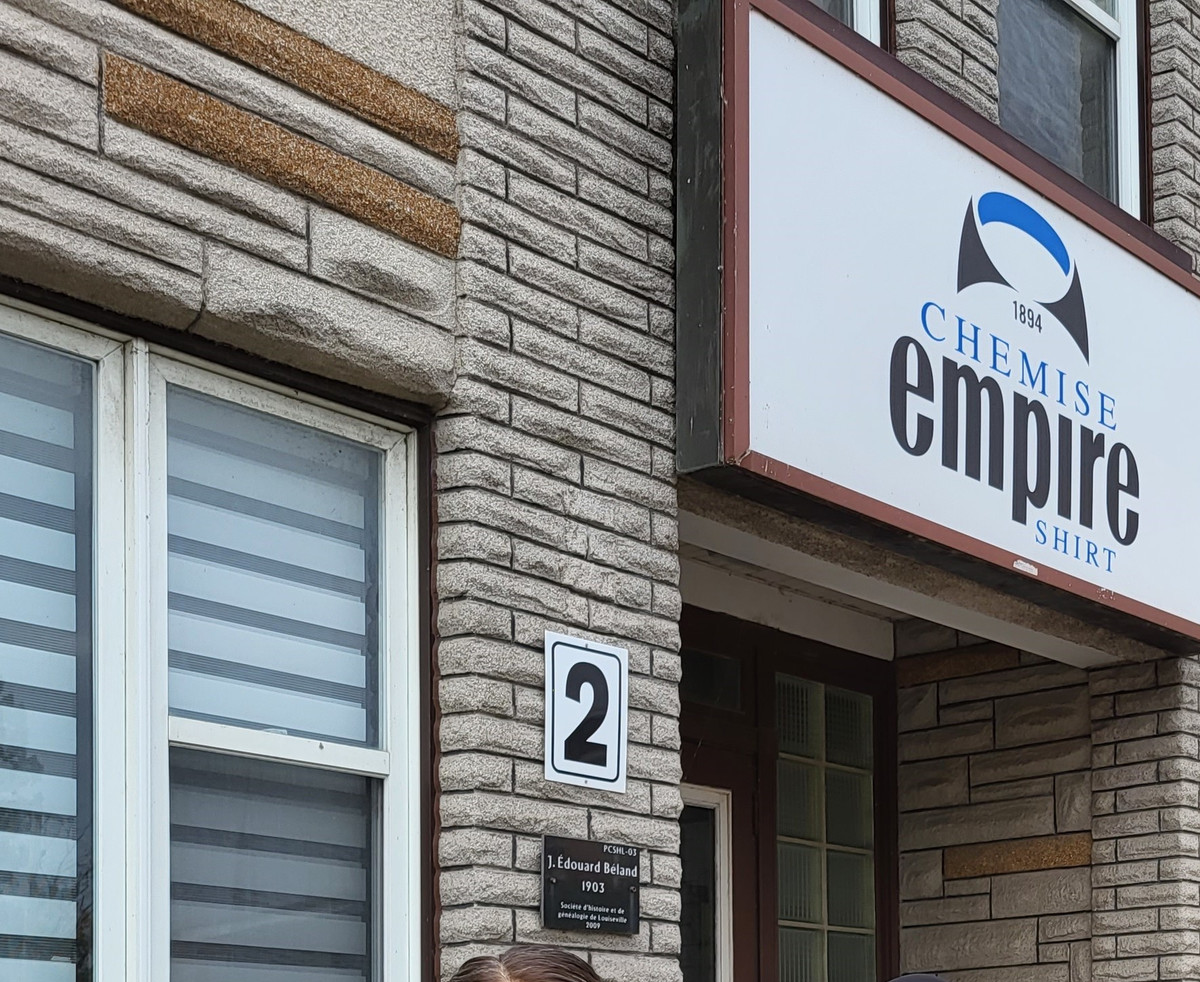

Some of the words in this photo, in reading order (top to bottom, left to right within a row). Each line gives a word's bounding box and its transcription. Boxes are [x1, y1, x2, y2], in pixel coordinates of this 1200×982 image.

[1012, 299, 1043, 333] 1894
[920, 301, 1118, 431] CHEMISE
[889, 335, 1140, 546] empire
[1035, 520, 1117, 573] SHIRT
[564, 661, 609, 767] 2
[603, 844, 637, 857] PCSHL-03
[547, 855, 556, 869] J.
[557, 854, 601, 873] Édouard
[603, 861, 638, 878] Béland
[582, 880, 605, 893] 1903
[557, 911, 589, 921] généalogie
[589, 913, 597, 921] de
[597, 914, 628, 923] Louiseville
[560, 901, 582, 910] Société
[583, 904, 610, 913] d'histoire
